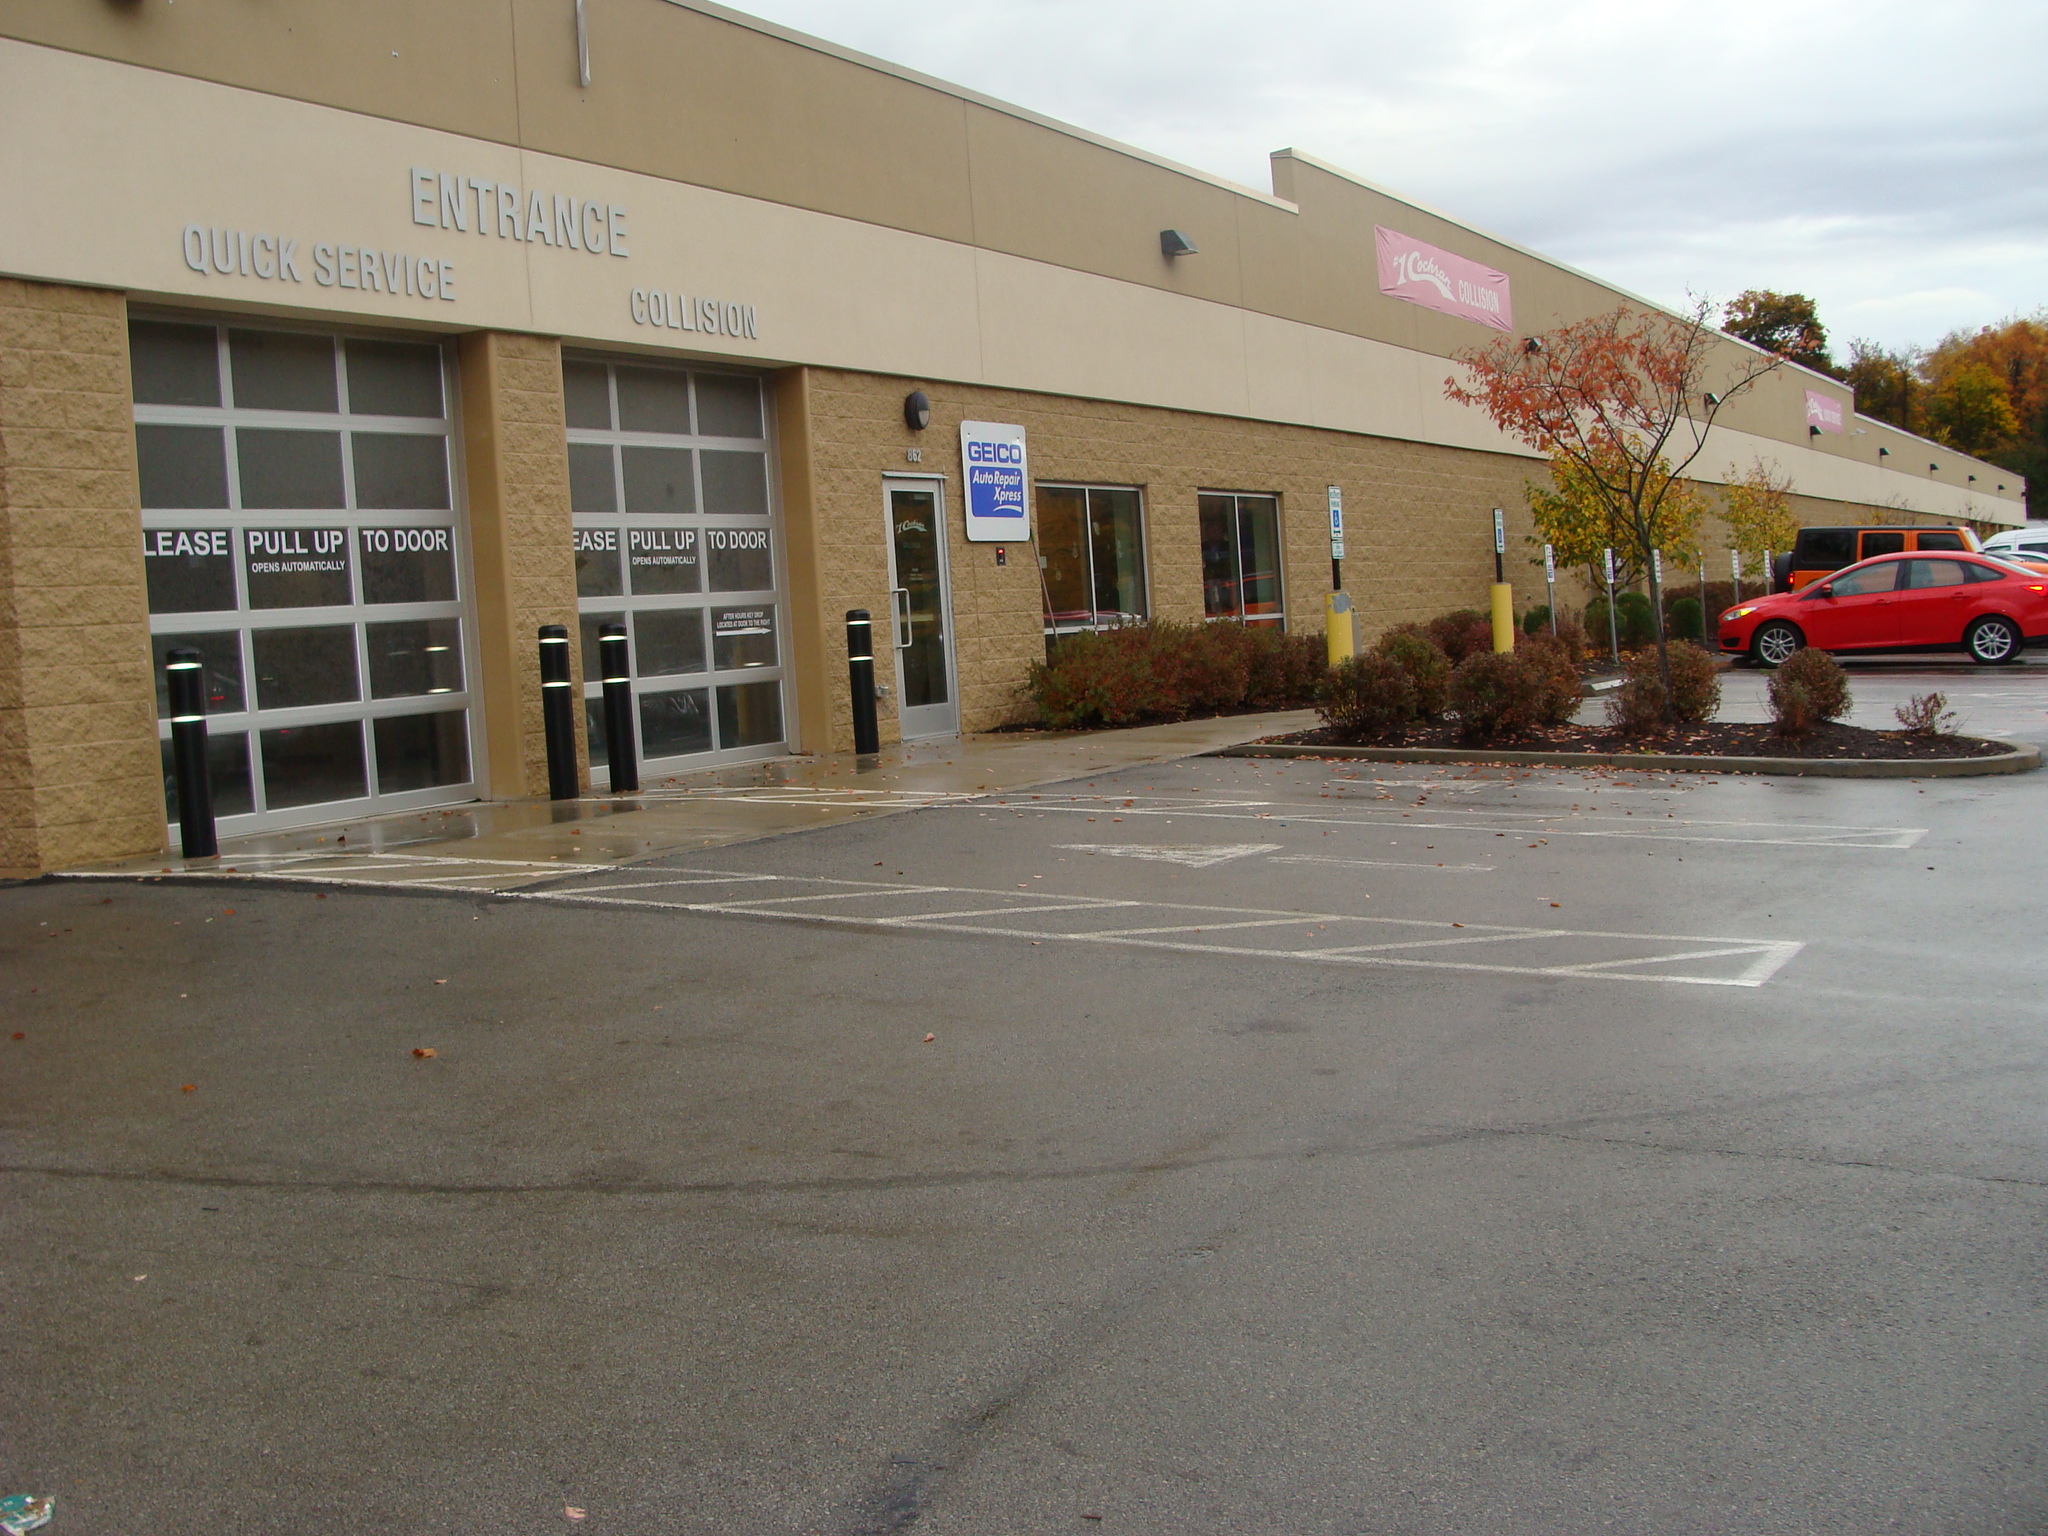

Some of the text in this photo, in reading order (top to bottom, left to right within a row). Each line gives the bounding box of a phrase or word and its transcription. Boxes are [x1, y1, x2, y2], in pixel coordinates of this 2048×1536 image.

[410, 165, 630, 258] ENTRANCE
[183, 221, 456, 302] QUICK SERVICE
[1407, 250, 1456, 300] Cochran
[1458, 279, 1500, 314] COLLISION
[630, 286, 758, 340] COLLISION
[907, 449, 922, 462] 862
[968, 441, 1022, 463] GEICO
[993, 486, 1022, 505] Xpress
[249, 529, 308, 555] PULL
[314, 530, 344, 554] UP
[363, 529, 389, 553] TO
[394, 529, 448, 552] DOOR
[631, 531, 671, 551] PULL
[675, 531, 695, 550] UP
[709, 530, 726, 550] TO
[729, 530, 767, 550] DOOR
[251, 560, 346, 573] OPENS AUTOMATICALLY
[632, 555, 697, 565] OPENS AUTOMATICALLY
[717, 620, 733, 629] LOCATED
[735, 612, 746, 620] HOURS
